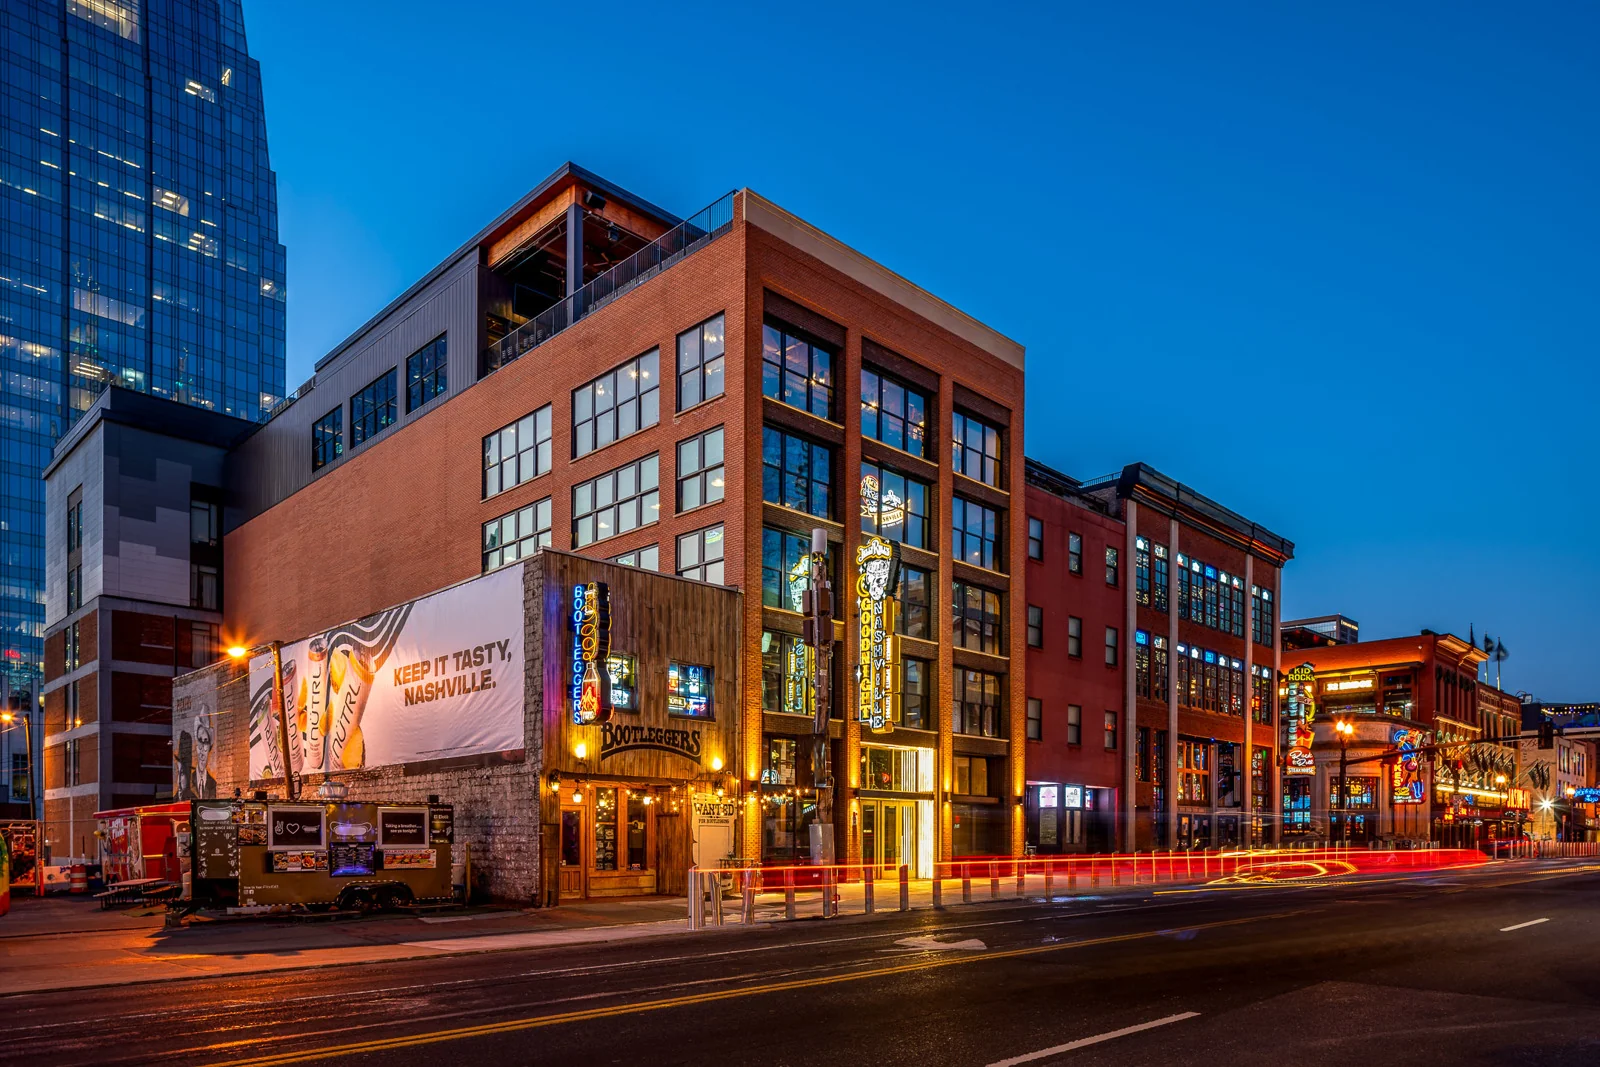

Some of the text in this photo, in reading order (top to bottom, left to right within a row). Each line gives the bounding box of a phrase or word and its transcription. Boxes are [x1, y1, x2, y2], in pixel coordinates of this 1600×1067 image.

[394, 638, 512, 687] KEEP IT TASTY,
[404, 668, 497, 707] NASHVILLE.
[573, 585, 582, 724] BOOTLEGGERS
[861, 598, 871, 719] GOODNIGHT
[873, 600, 883, 729] NASHVILLE
[1294, 667, 1311, 675] KID
[286, 684, 299, 752] NÜTRL
[310, 664, 322, 741] NÜTRL
[332, 683, 362, 760] NÜTRL
[601, 721, 700, 756] BOOTLEGGERS
[694, 803, 735, 816] WANTED
